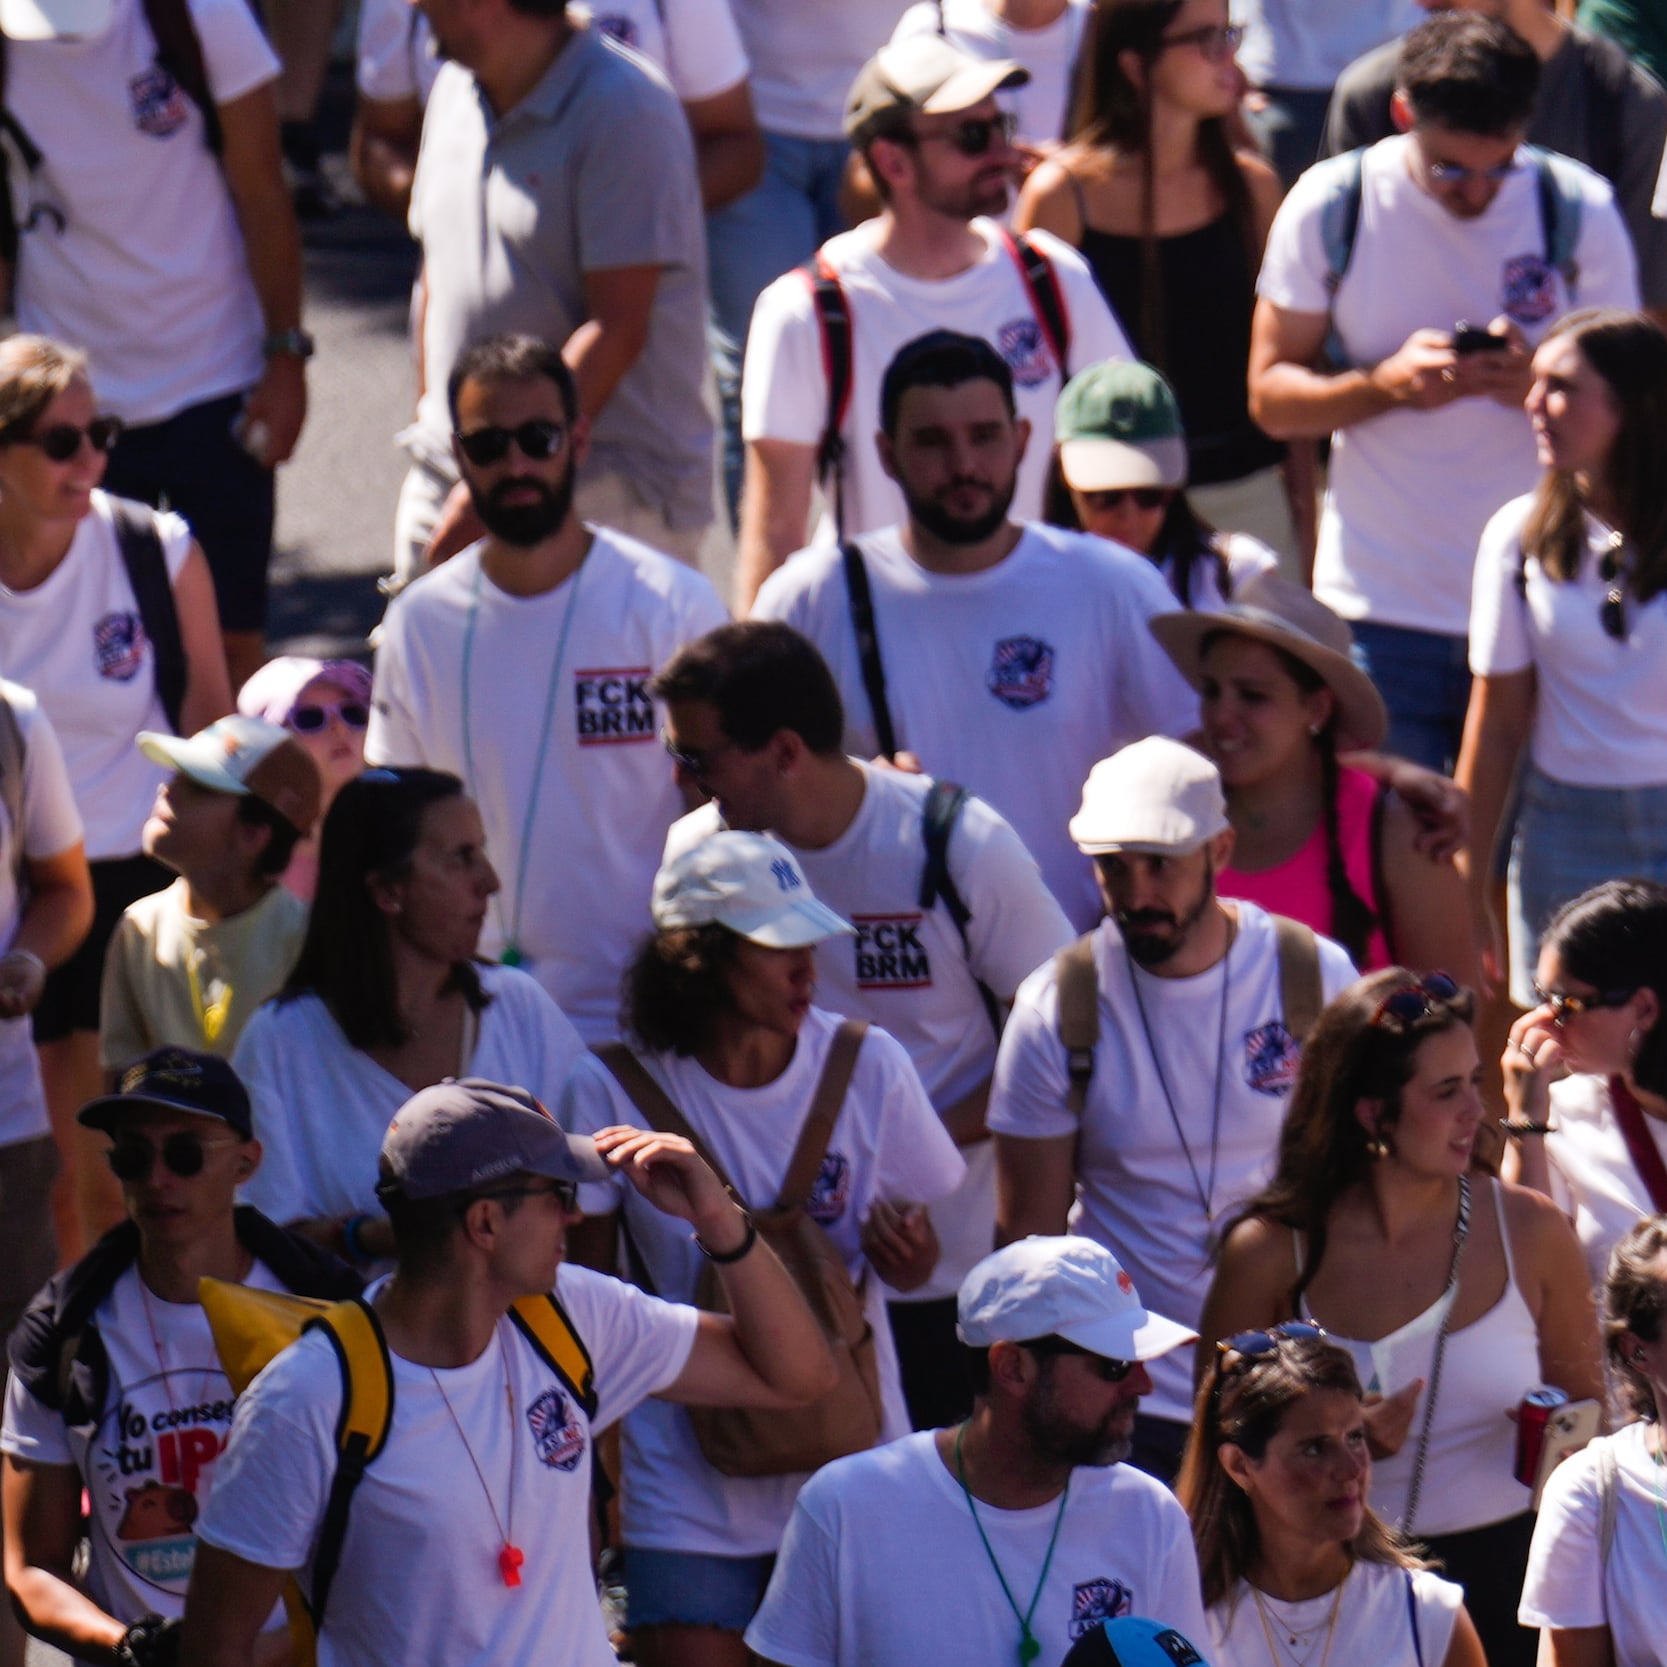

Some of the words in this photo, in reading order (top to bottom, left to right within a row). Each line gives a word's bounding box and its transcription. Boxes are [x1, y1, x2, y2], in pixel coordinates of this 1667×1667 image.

[576, 679, 653, 706] FCK
[578, 708, 655, 734] BRM
[854, 922, 924, 952] FCK
[857, 953, 929, 978] BRM
[118, 1443, 152, 1476] tu
[157, 1427, 231, 1494] IP
